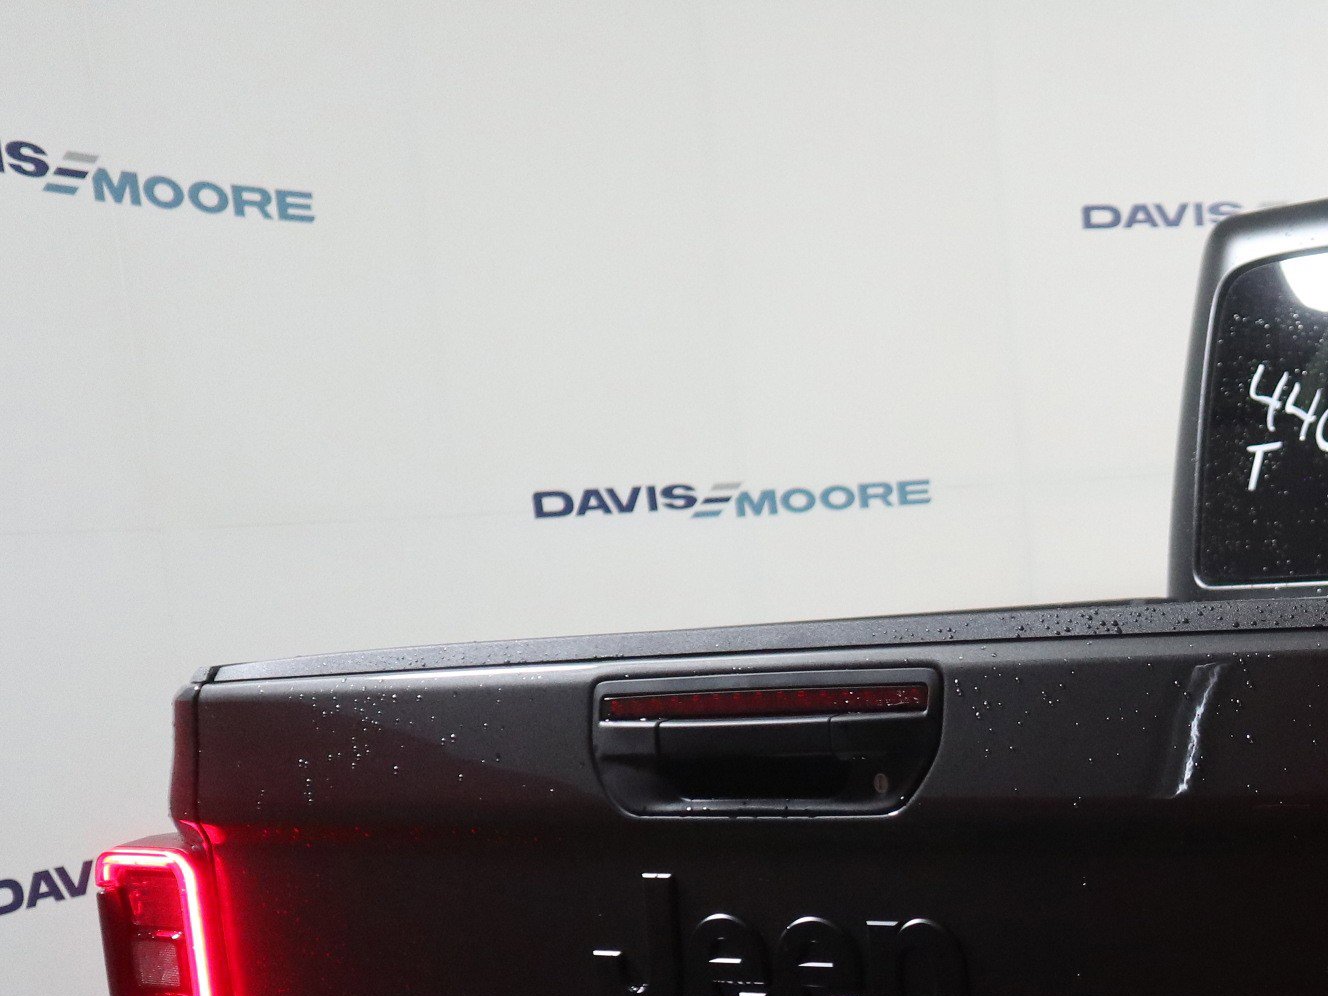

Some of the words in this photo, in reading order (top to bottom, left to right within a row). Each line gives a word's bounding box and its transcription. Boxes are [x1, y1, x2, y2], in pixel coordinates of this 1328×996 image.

[92, 167, 316, 223] MOORE
[1246, 441, 1283, 491] T
[532, 484, 698, 519] DAVIS
[734, 479, 931, 518] MOORE
